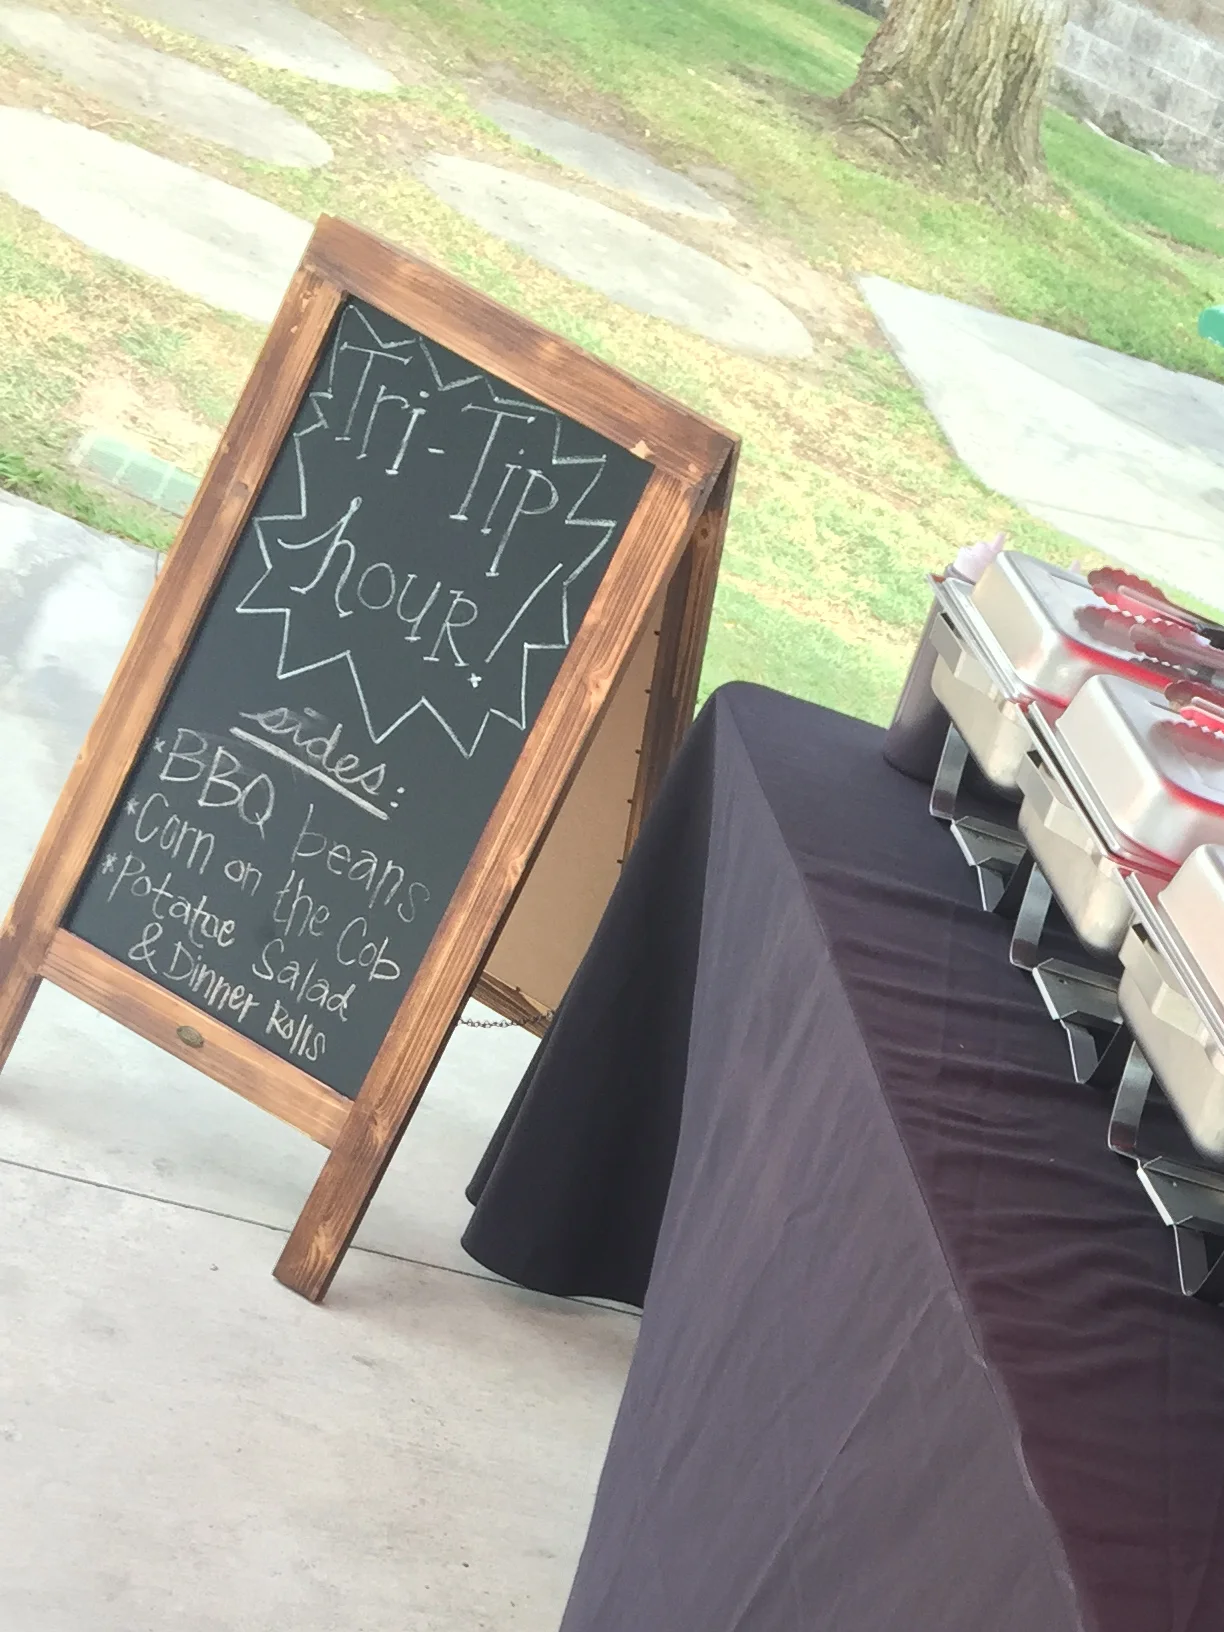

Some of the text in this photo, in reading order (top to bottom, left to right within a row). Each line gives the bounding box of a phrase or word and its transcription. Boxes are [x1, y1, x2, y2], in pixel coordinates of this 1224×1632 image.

[334, 341, 559, 577] Tri-Tip
[239, 707, 405, 808] sides:
[134, 793, 401, 982] Corn on the Cob
[291, 803, 430, 923] beans
[128, 922, 327, 1061] & Dinner Rolls
[252, 938, 357, 1022] Salad
